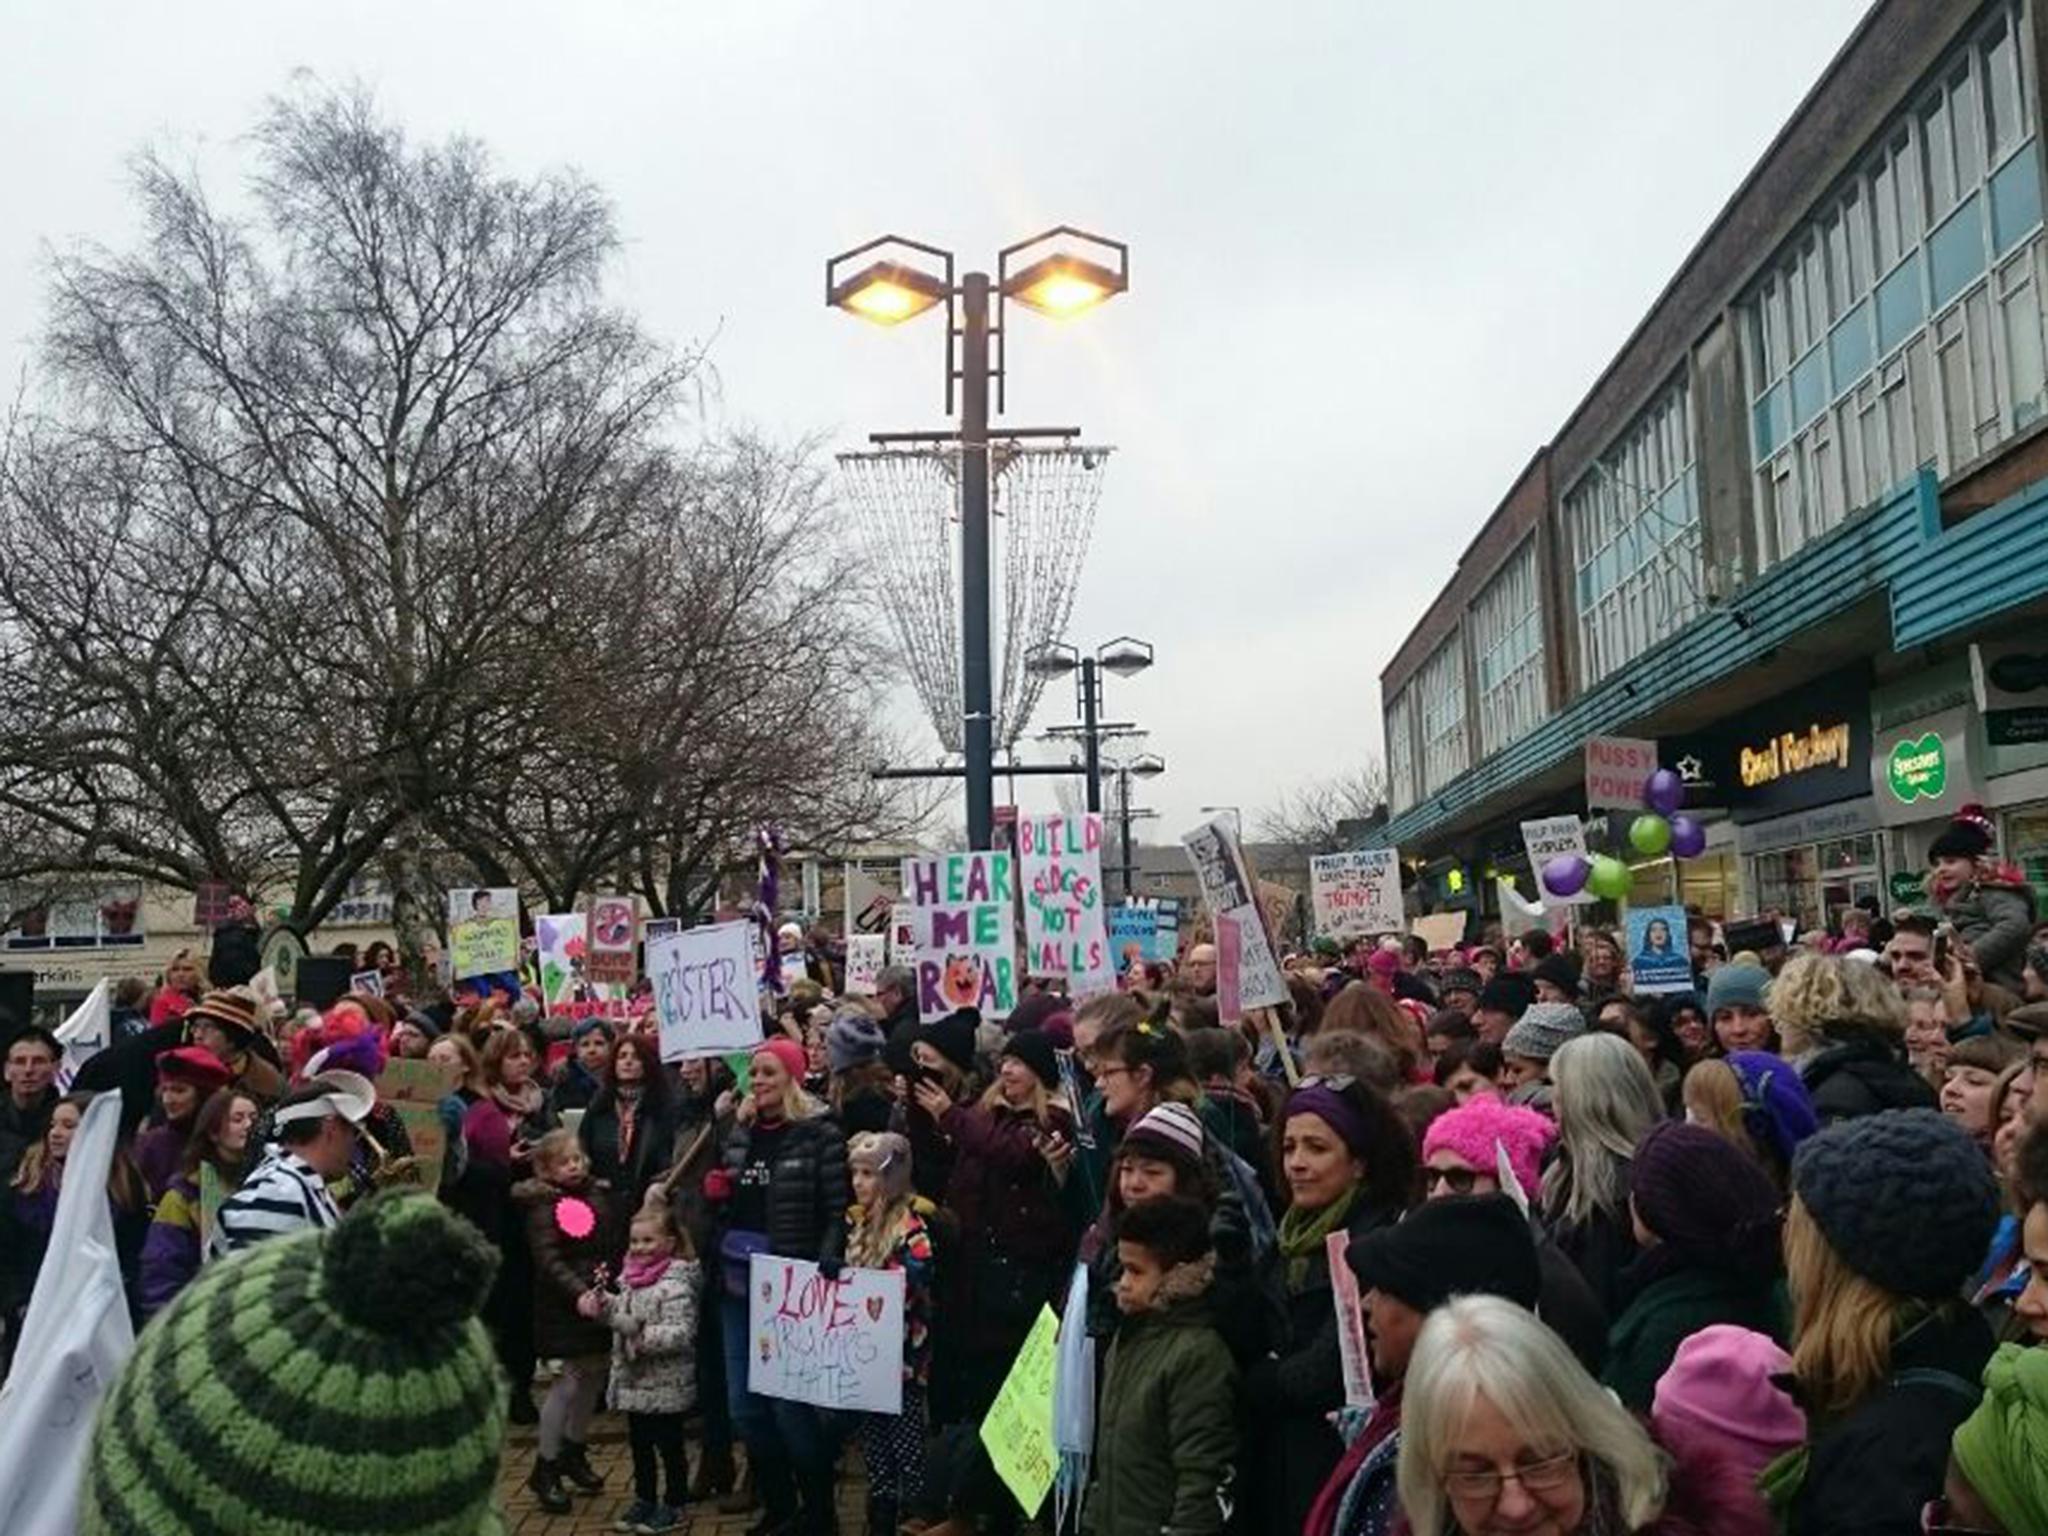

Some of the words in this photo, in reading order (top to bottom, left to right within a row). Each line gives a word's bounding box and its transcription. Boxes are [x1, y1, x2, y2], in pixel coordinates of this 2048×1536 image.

[1588, 741, 1652, 768] PUSSY
[1589, 775, 1644, 800] POWE
[1019, 817, 1100, 858] BUILD
[912, 854, 1011, 907] HEAR
[931, 907, 999, 949] ME
[1042, 906, 1080, 935] NOT
[32, 967, 83, 984] erkins
[1029, 941, 1101, 973] WALLS
[917, 953, 1013, 1015] ROAR
[777, 1265, 858, 1332] LOVE
[774, 1363, 860, 1403] HATE
